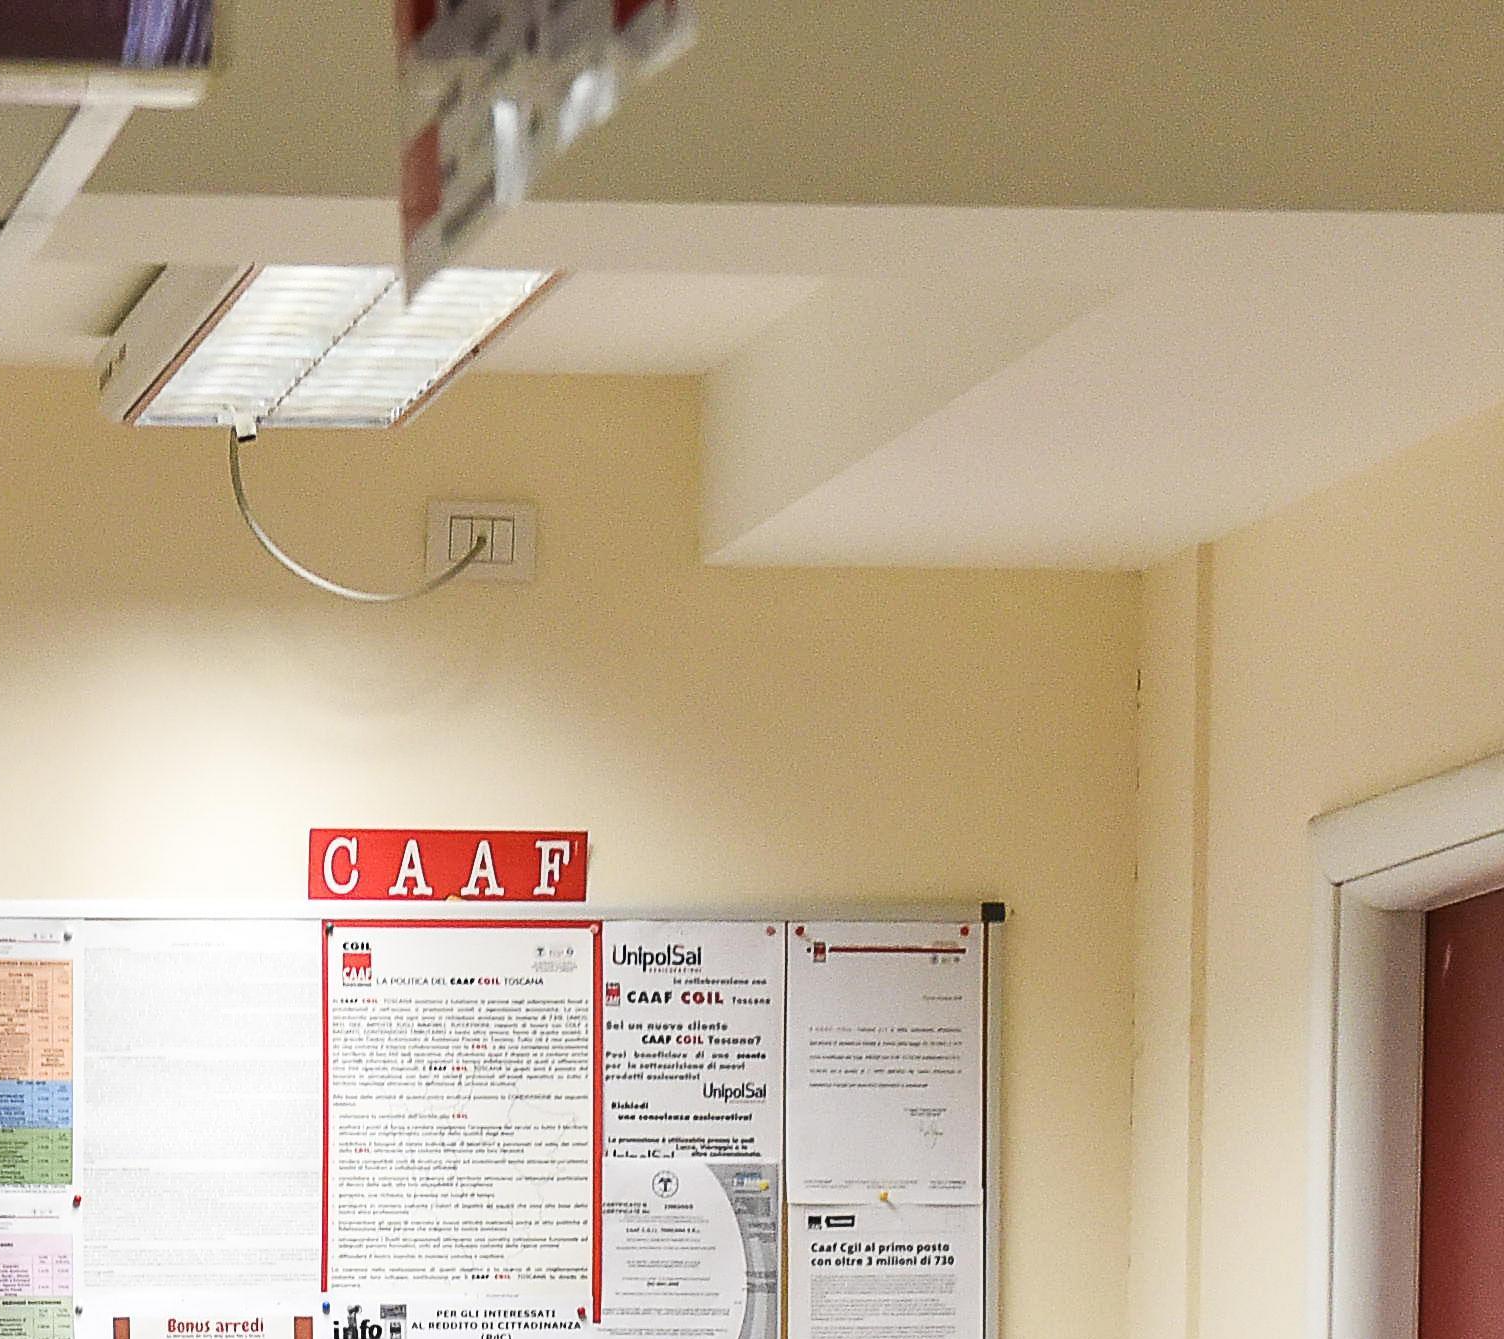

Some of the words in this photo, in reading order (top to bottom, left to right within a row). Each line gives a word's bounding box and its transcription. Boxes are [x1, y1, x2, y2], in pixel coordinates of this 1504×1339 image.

[323, 837, 570, 896] CAAF
[342, 941, 371, 951] CGIL
[342, 967, 372, 981] CAAF
[377, 977, 388, 985] LA
[390, 977, 429, 985] POLITICA
[431, 977, 447, 985] DEL
[450, 977, 477, 985] CAAF
[478, 977, 501, 985] CGIL
[504, 977, 544, 985] TOSCANA
[627, 991, 672, 1004] CAAF
[680, 991, 724, 1005] CGIL
[732, 996, 771, 1005] Toscana
[606, 1021, 624, 1031] Sei
[628, 1021, 643, 1031] un
[647, 1021, 683, 1031] nuovo
[687, 1021, 728, 1031] cliente
[641, 1035, 672, 1045] CAAF
[675, 1035, 704, 1045] CGIL
[707, 1035, 762, 1045] Toscana?
[811, 1242, 838, 1253] Caaf
[840, 1242, 861, 1256] Cgil
[865, 1242, 876, 1253] al
[878, 1243, 913, 1256] primo
[916, 1244, 950, 1256] posto
[811, 1256, 831, 1267] con
[834, 1256, 863, 1267] oltre
[867, 1256, 873, 1267] 3
[876, 1256, 917, 1267] milioni
[920, 1256, 931, 1267] di
[933, 1256, 955, 1267] 730
[436, 1309, 458, 1318] PER
[465, 1309, 479, 1318] GLI
[484, 1309, 556, 1318] INTERESSATI
[167, 1317, 211, 1334] Bonus
[216, 1316, 264, 1334] arredi
[411, 1321, 425, 1330] AL
[428, 1321, 477, 1330] REDDITO
[482, 1321, 494, 1330] DI
[497, 1321, 582, 1330] CITTADINANZA
